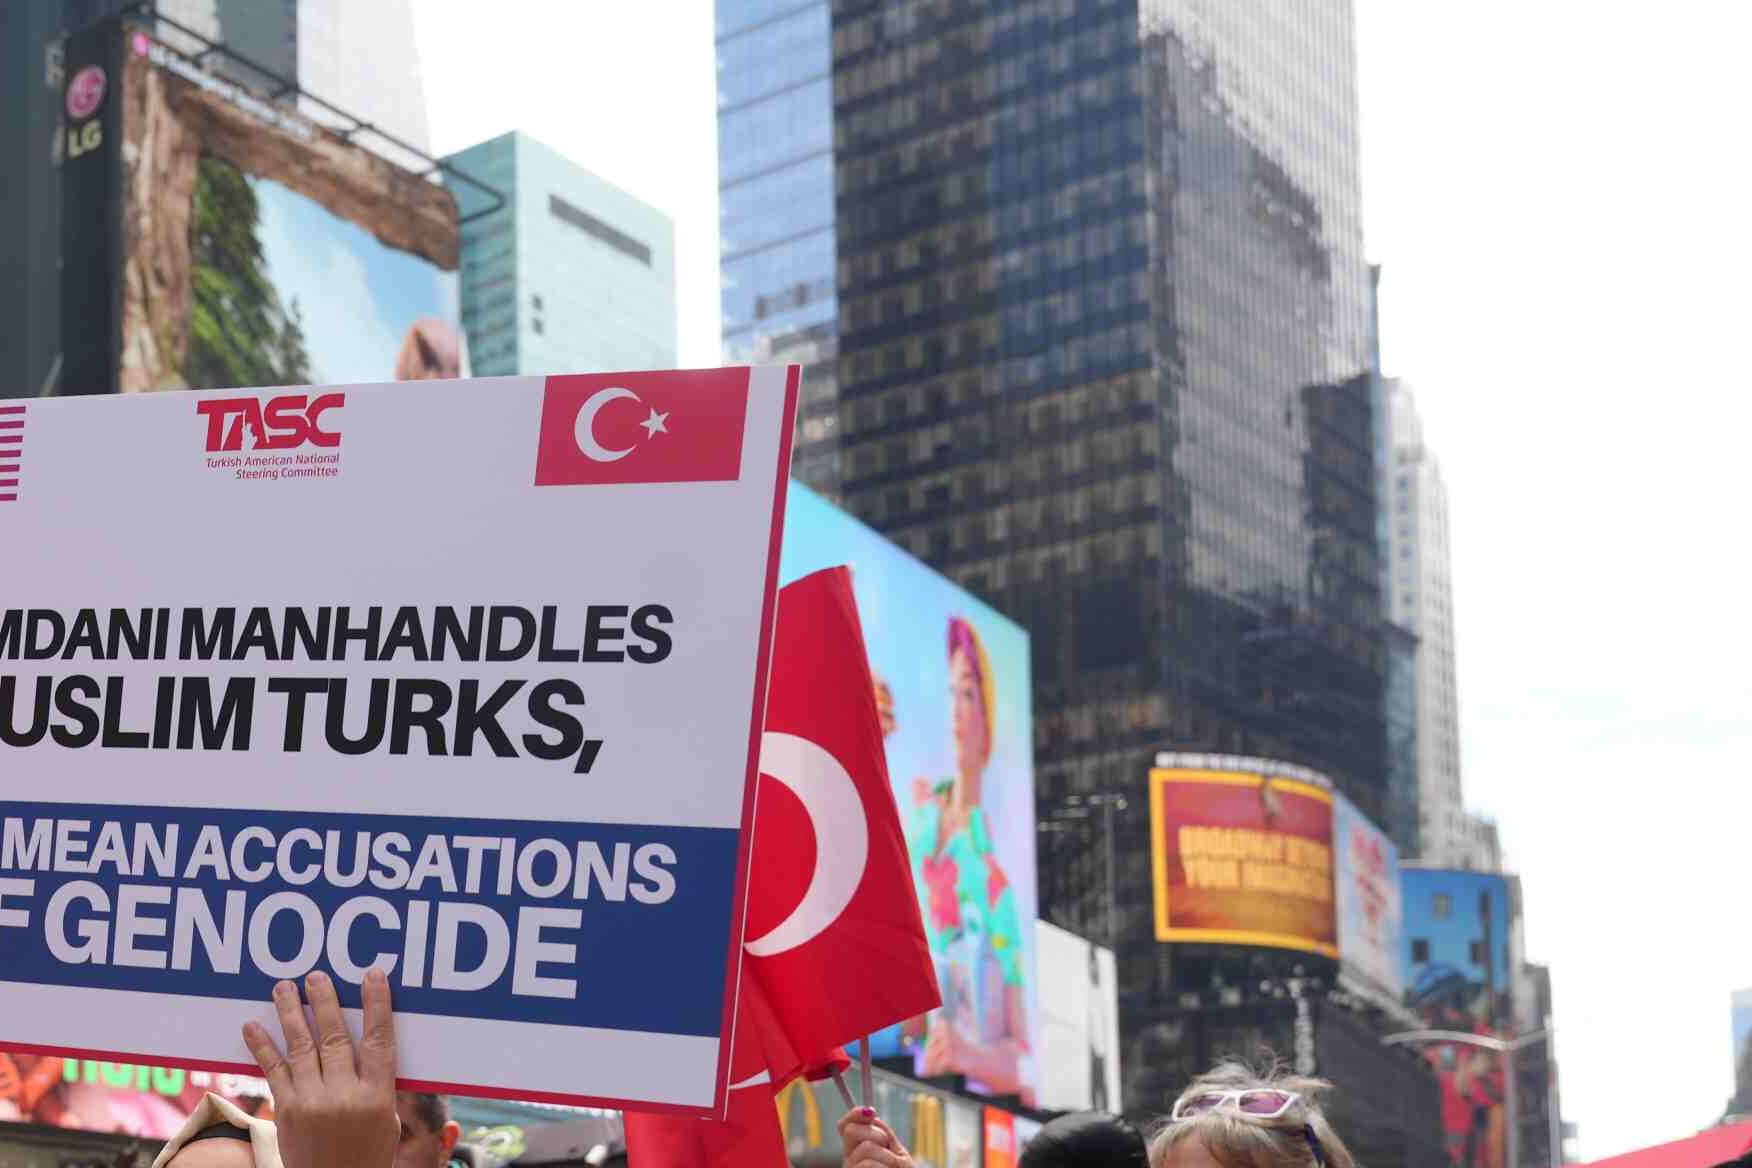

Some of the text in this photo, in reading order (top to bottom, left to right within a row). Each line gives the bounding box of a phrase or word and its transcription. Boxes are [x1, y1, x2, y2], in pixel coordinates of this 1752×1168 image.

[67, 120, 103, 158] LG
[197, 393, 346, 453] TASC
[206, 453, 340, 468] Turkish American National
[235, 466, 339, 481] Steering Committee
[178, 604, 674, 665] MANHANDLES
[267, 677, 604, 775] TURKS,
[1, 819, 180, 877] MEAN
[184, 825, 677, 905] ACCUSATIONS
[45, 880, 583, 999] GENOCIDE
